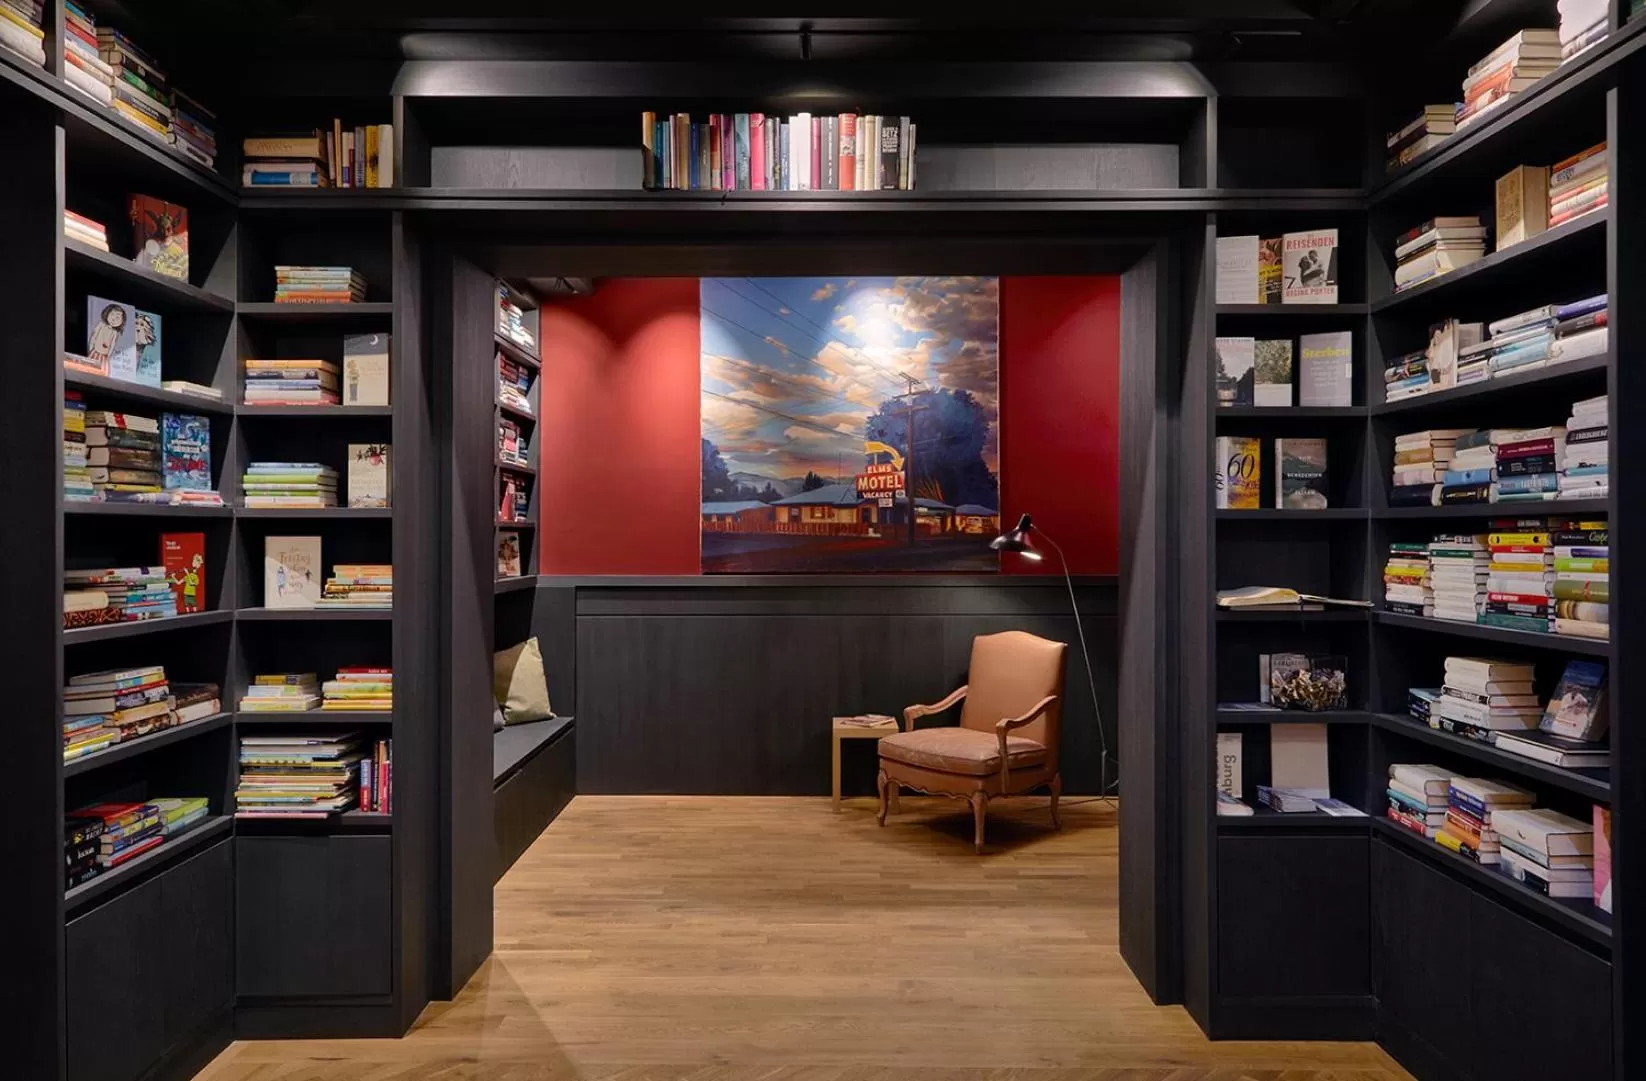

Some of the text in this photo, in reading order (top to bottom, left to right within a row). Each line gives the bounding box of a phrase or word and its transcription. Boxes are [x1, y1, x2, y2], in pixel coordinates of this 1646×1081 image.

[1286, 236, 1335, 250] REISENDEN
[867, 465, 892, 474] ELMS
[1227, 453, 1255, 479] 60
[858, 475, 902, 491] MOTEL
[862, 491, 893, 499] VACANCY
